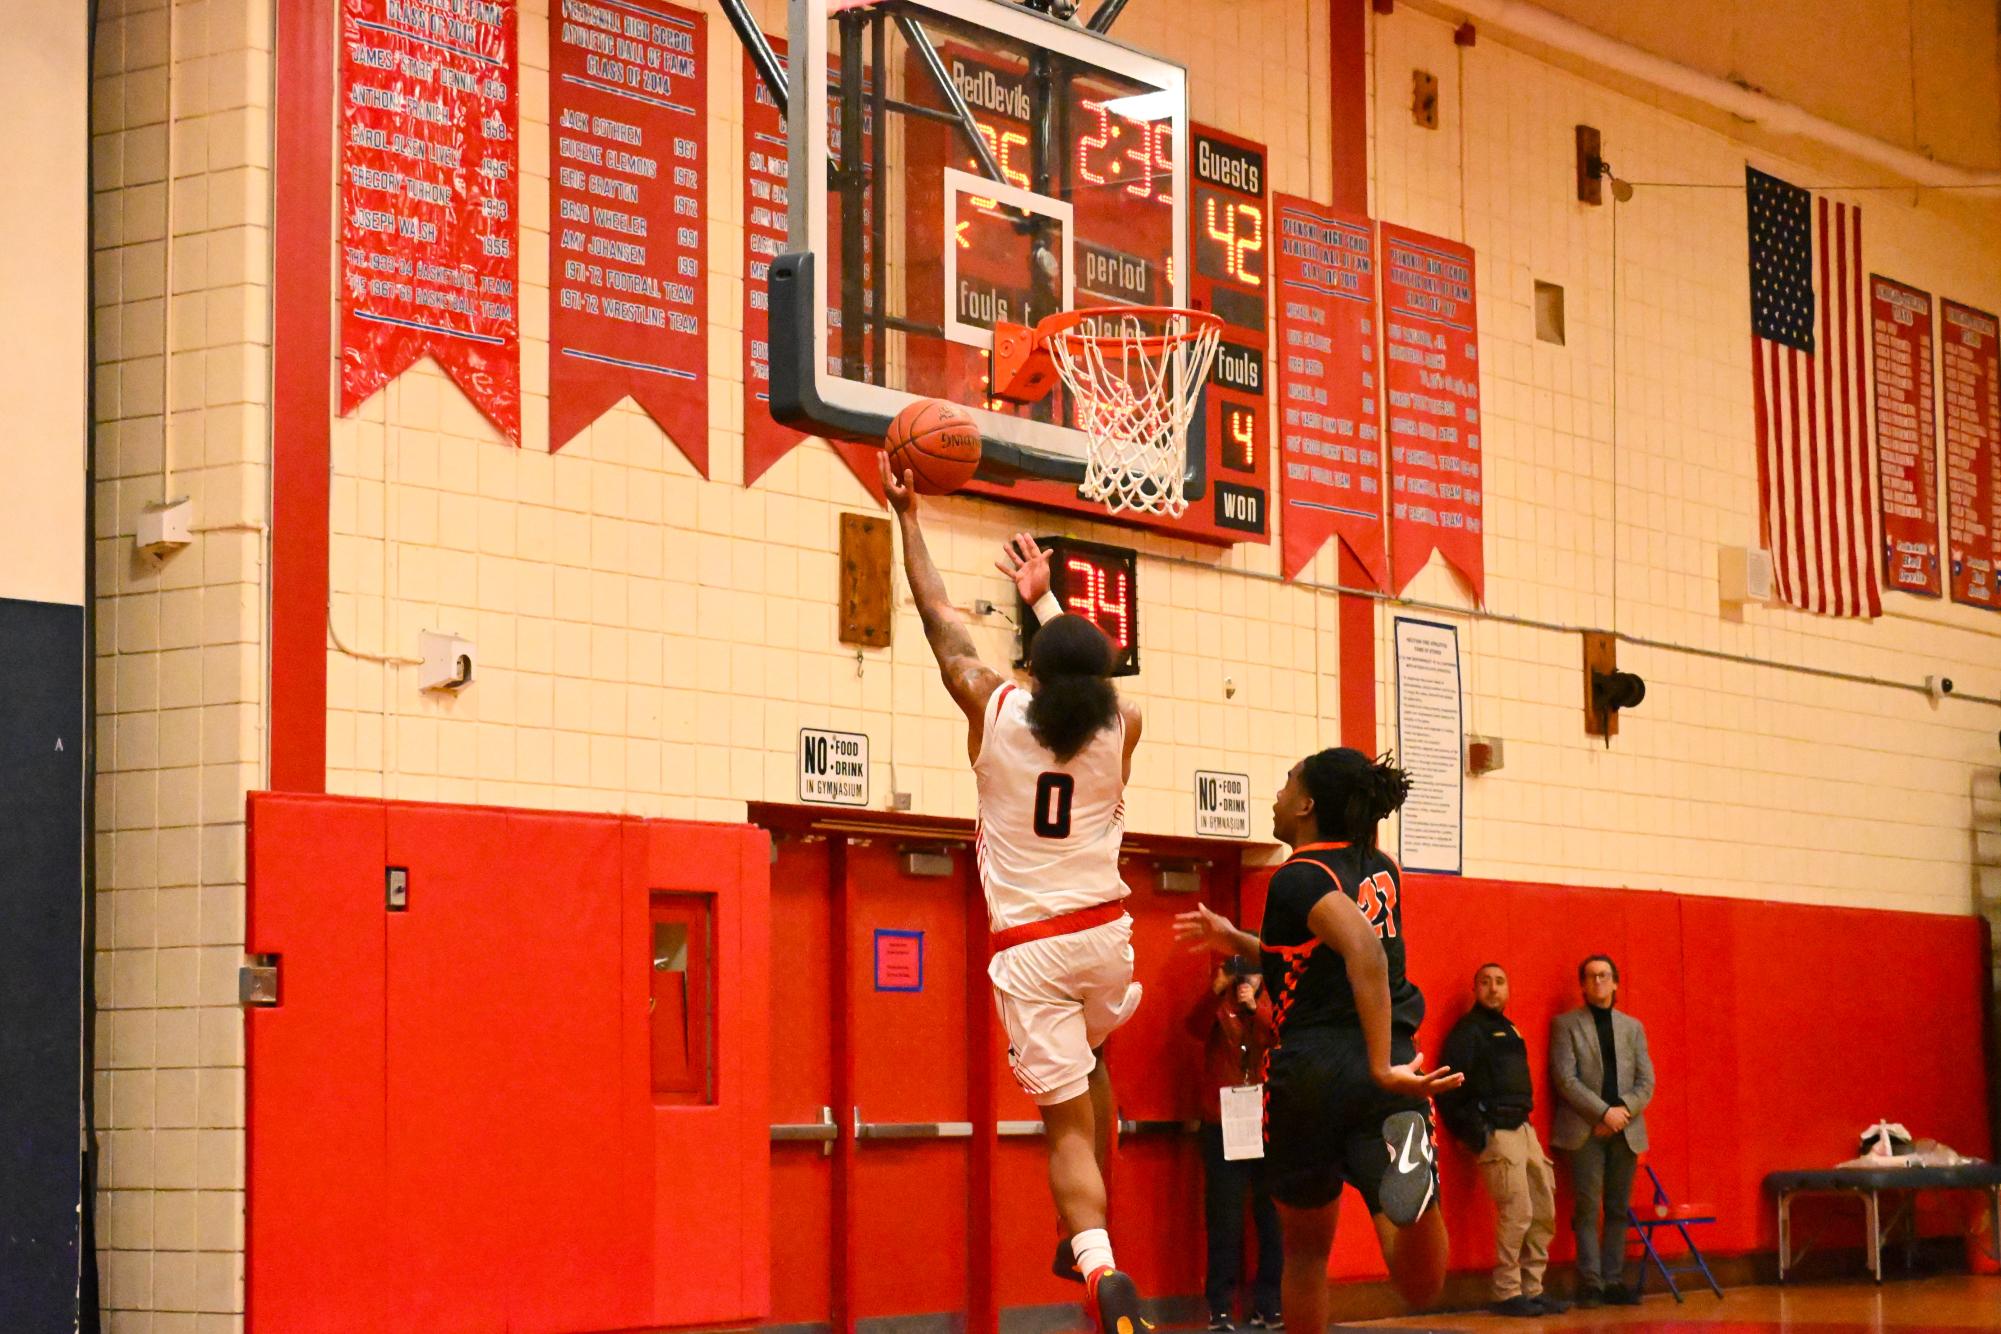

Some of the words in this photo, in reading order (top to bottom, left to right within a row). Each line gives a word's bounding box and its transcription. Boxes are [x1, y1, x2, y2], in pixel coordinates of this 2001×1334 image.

[352, 45, 393, 70] JAMES
[587, 54, 624, 83] CLASS
[627, 66, 641, 88] OF
[663, 52, 696, 79] FAME
[352, 125, 390, 149] CAROL
[560, 108, 589, 133] JACK
[673, 137, 698, 160] 1967
[351, 165, 401, 192] GREGORY
[560, 137, 602, 165] EUGENE
[606, 149, 657, 179] CLEMONS
[673, 166, 698, 190] 1972
[1199, 140, 1259, 194] Guests
[560, 166, 586, 191] ERIC
[674, 195, 698, 218] 1972
[353, 209, 395, 234] JOSEPH
[482, 237, 510, 258] 1955
[560, 199, 590, 224] BRAD
[593, 206, 648, 237] WHEELER
[677, 227, 699, 249] 1991
[1207, 197, 1262, 286] 42
[561, 228, 586, 252] AMY
[587, 236, 646, 266] JOHANSEN
[677, 256, 698, 278] 1991
[1086, 249, 1147, 293] period
[416, 260, 478, 292] BASKETBALL
[481, 277, 513, 297] TEAM
[606, 268, 662, 299] FOOTBALL
[663, 281, 694, 305] TEAM
[415, 287, 477, 315] BASKETBALL
[481, 301, 512, 320] TEAM
[601, 296, 666, 329] WRESTLING
[667, 311, 698, 336] TEAM
[1232, 410, 1254, 465] 4
[1067, 559, 1128, 648] 34
[805, 735, 828, 776] NO
[835, 740, 859, 757] FOOD
[835, 760, 864, 777] DRINK
[807, 779, 814, 793] IN
[817, 780, 862, 798] GYMNASIUM
[1033, 771, 1075, 840] 0
[1199, 776, 1217, 812] NO
[1223, 780, 1242, 795] FOOD
[1223, 798, 1246, 813] DRINK
[1201, 815, 1208, 828] IN
[1209, 816, 1245, 831] GYMNASIUM
